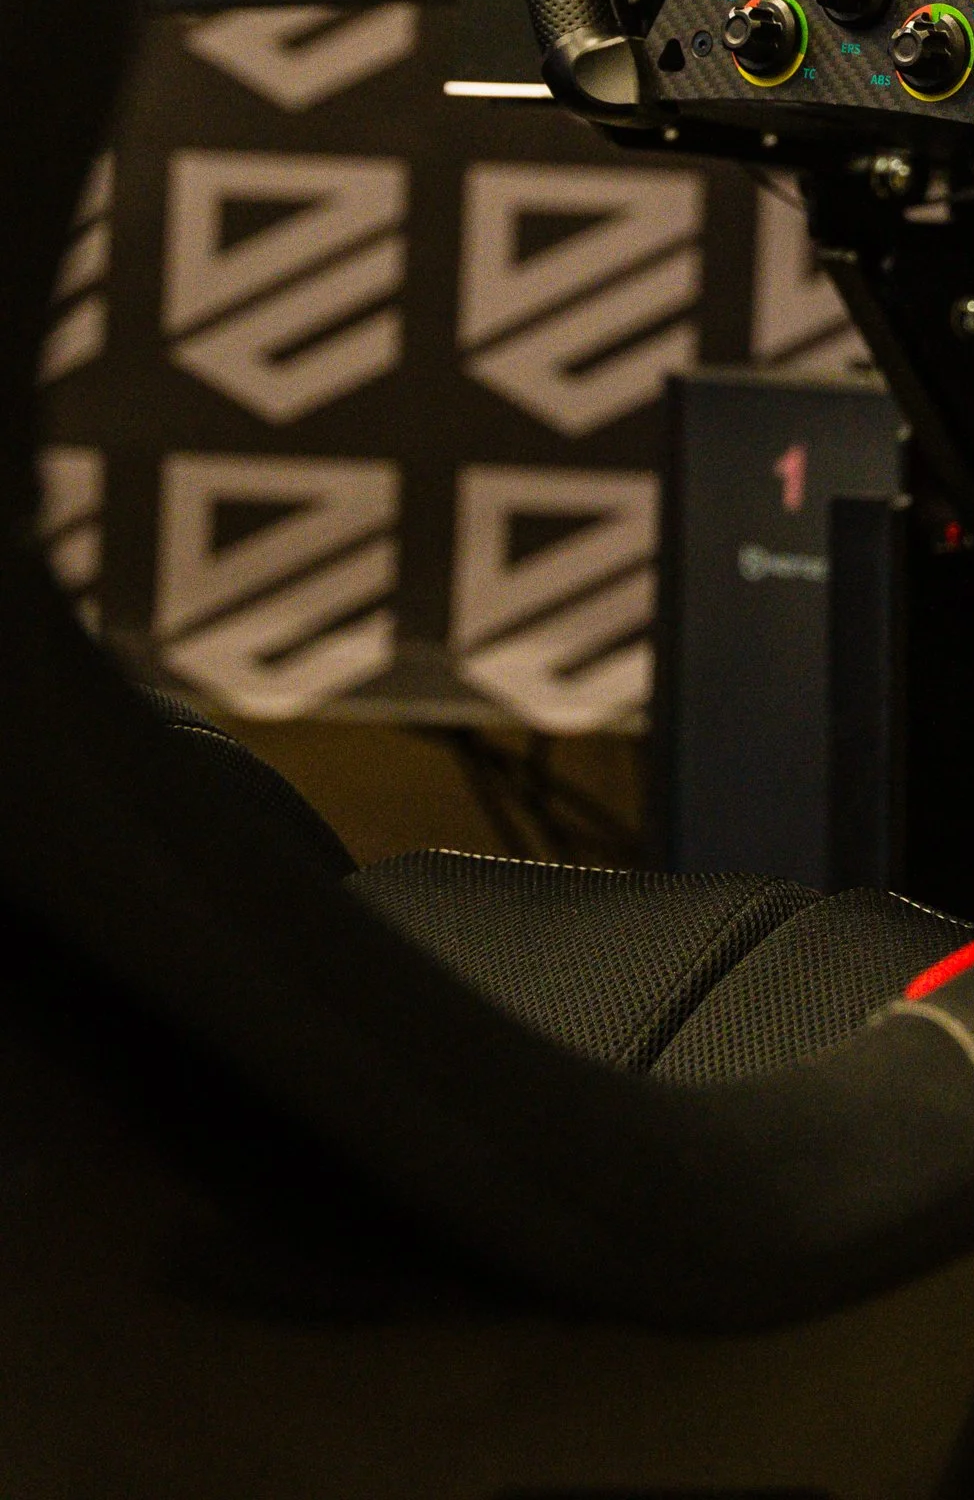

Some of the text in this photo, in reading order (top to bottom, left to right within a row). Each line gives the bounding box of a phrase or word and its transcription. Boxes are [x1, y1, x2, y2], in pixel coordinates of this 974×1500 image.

[841, 43, 861, 55] ERS
[803, 68, 816, 79] TC
[871, 75, 890, 86] ABS
[774, 441, 808, 511] 1
